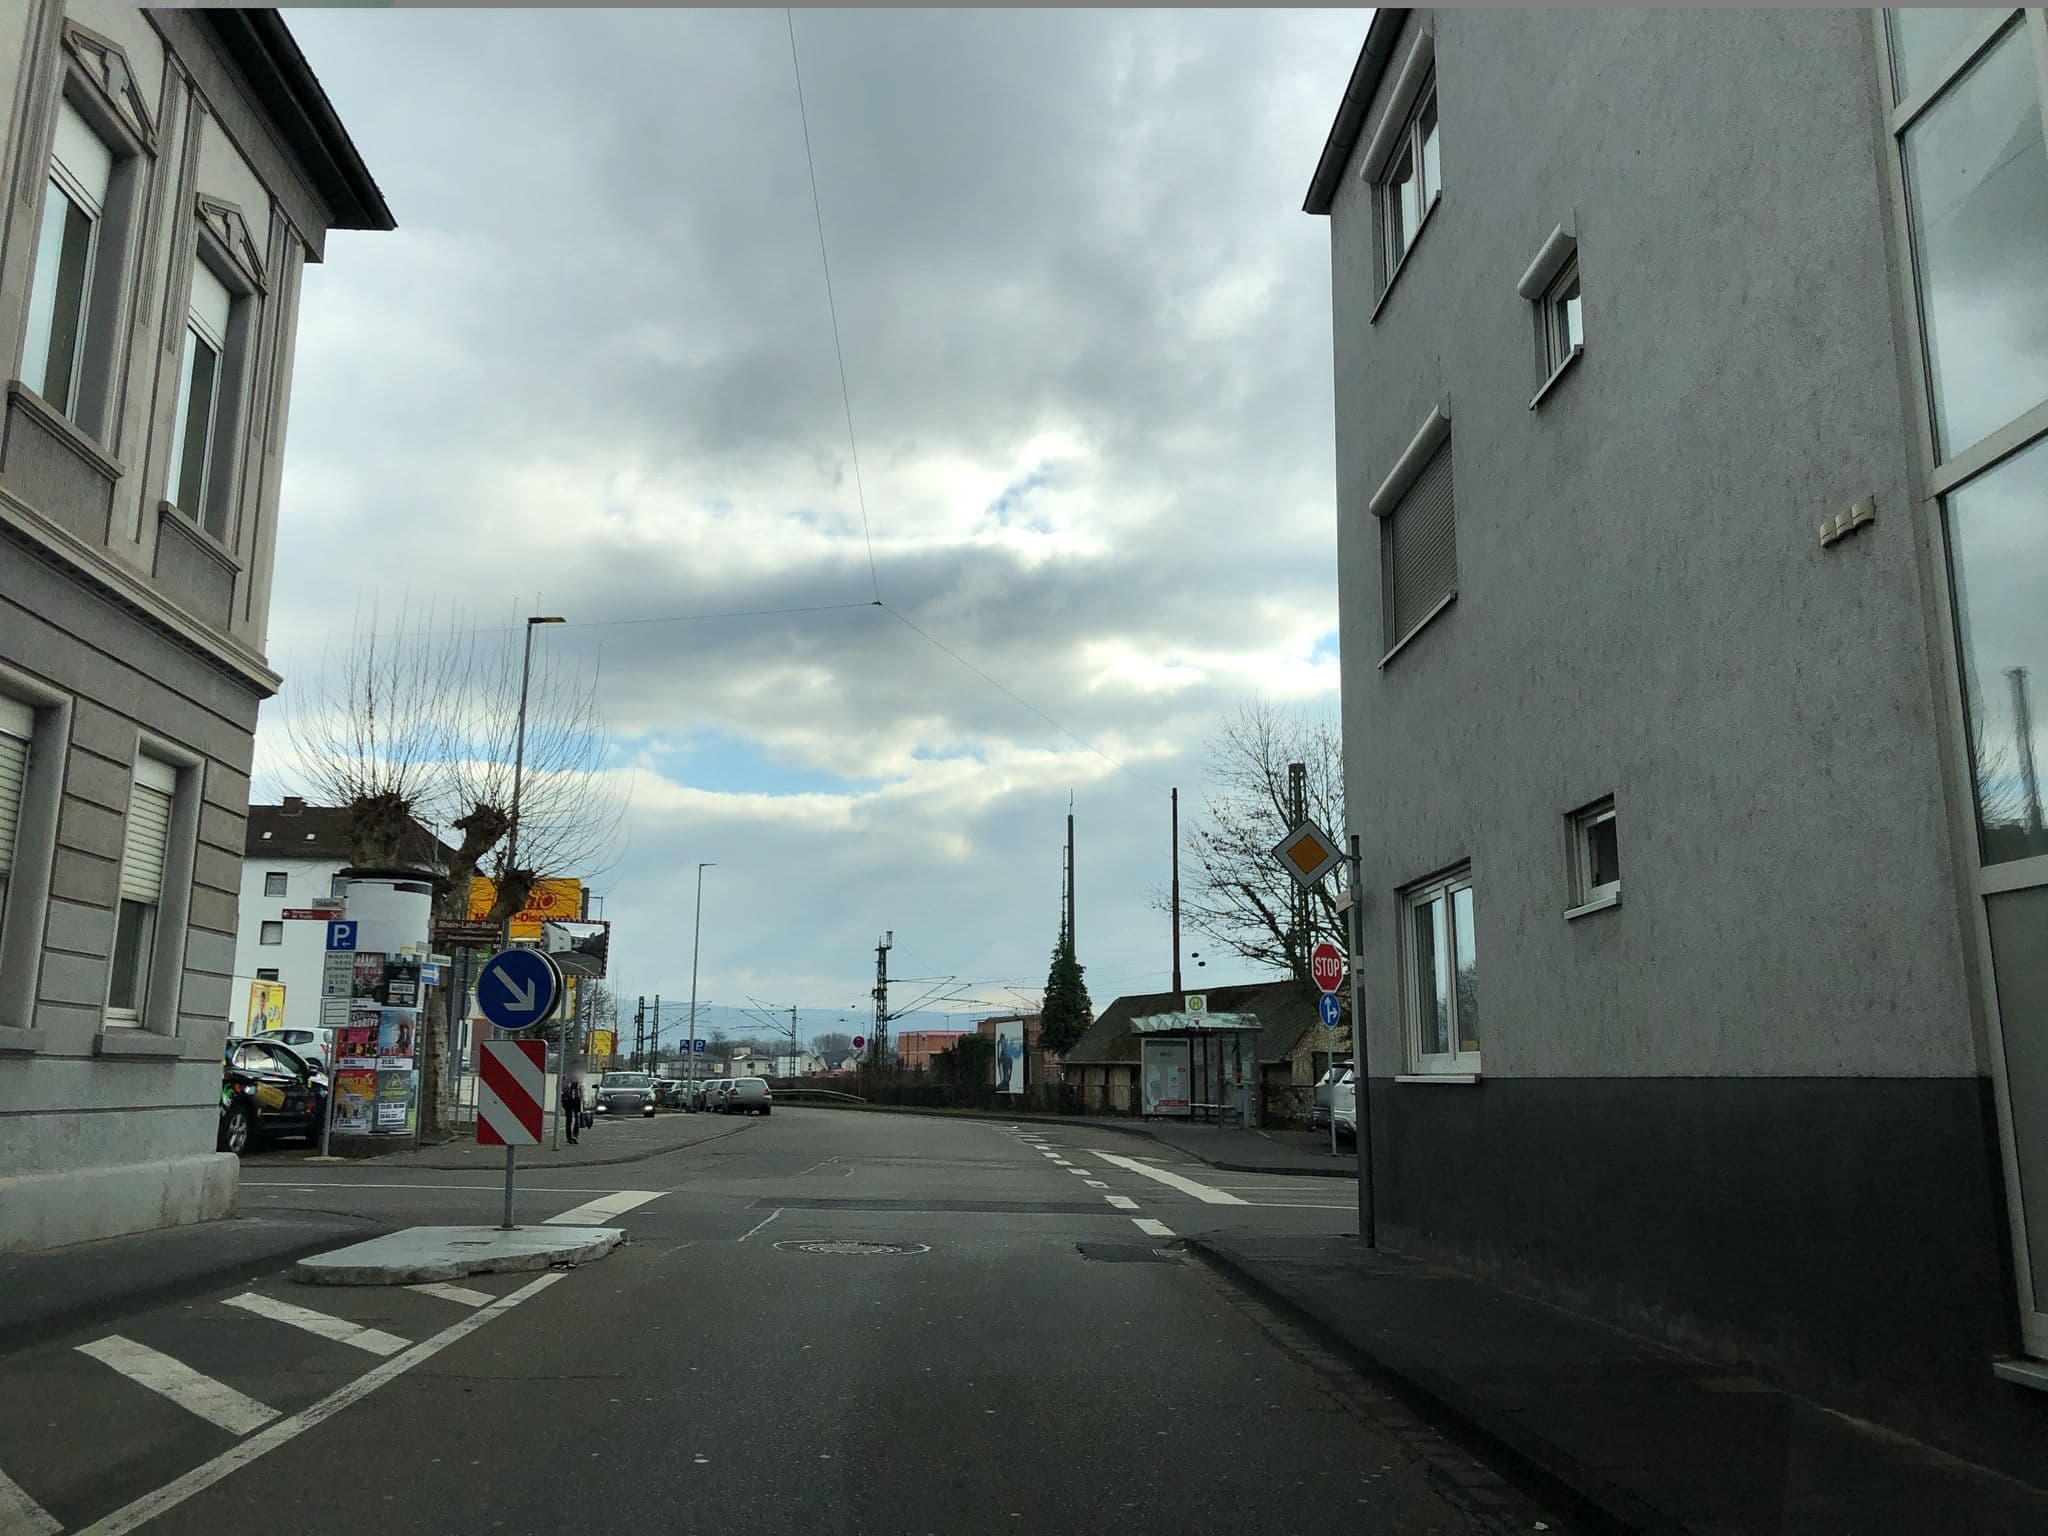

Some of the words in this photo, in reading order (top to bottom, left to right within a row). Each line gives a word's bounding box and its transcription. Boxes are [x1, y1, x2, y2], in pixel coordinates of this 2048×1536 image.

[438, 920, 499, 929] Rhein-Lahn-Bahn
[333, 924, 350, 947] P
[1315, 957, 1340, 977] STOP
